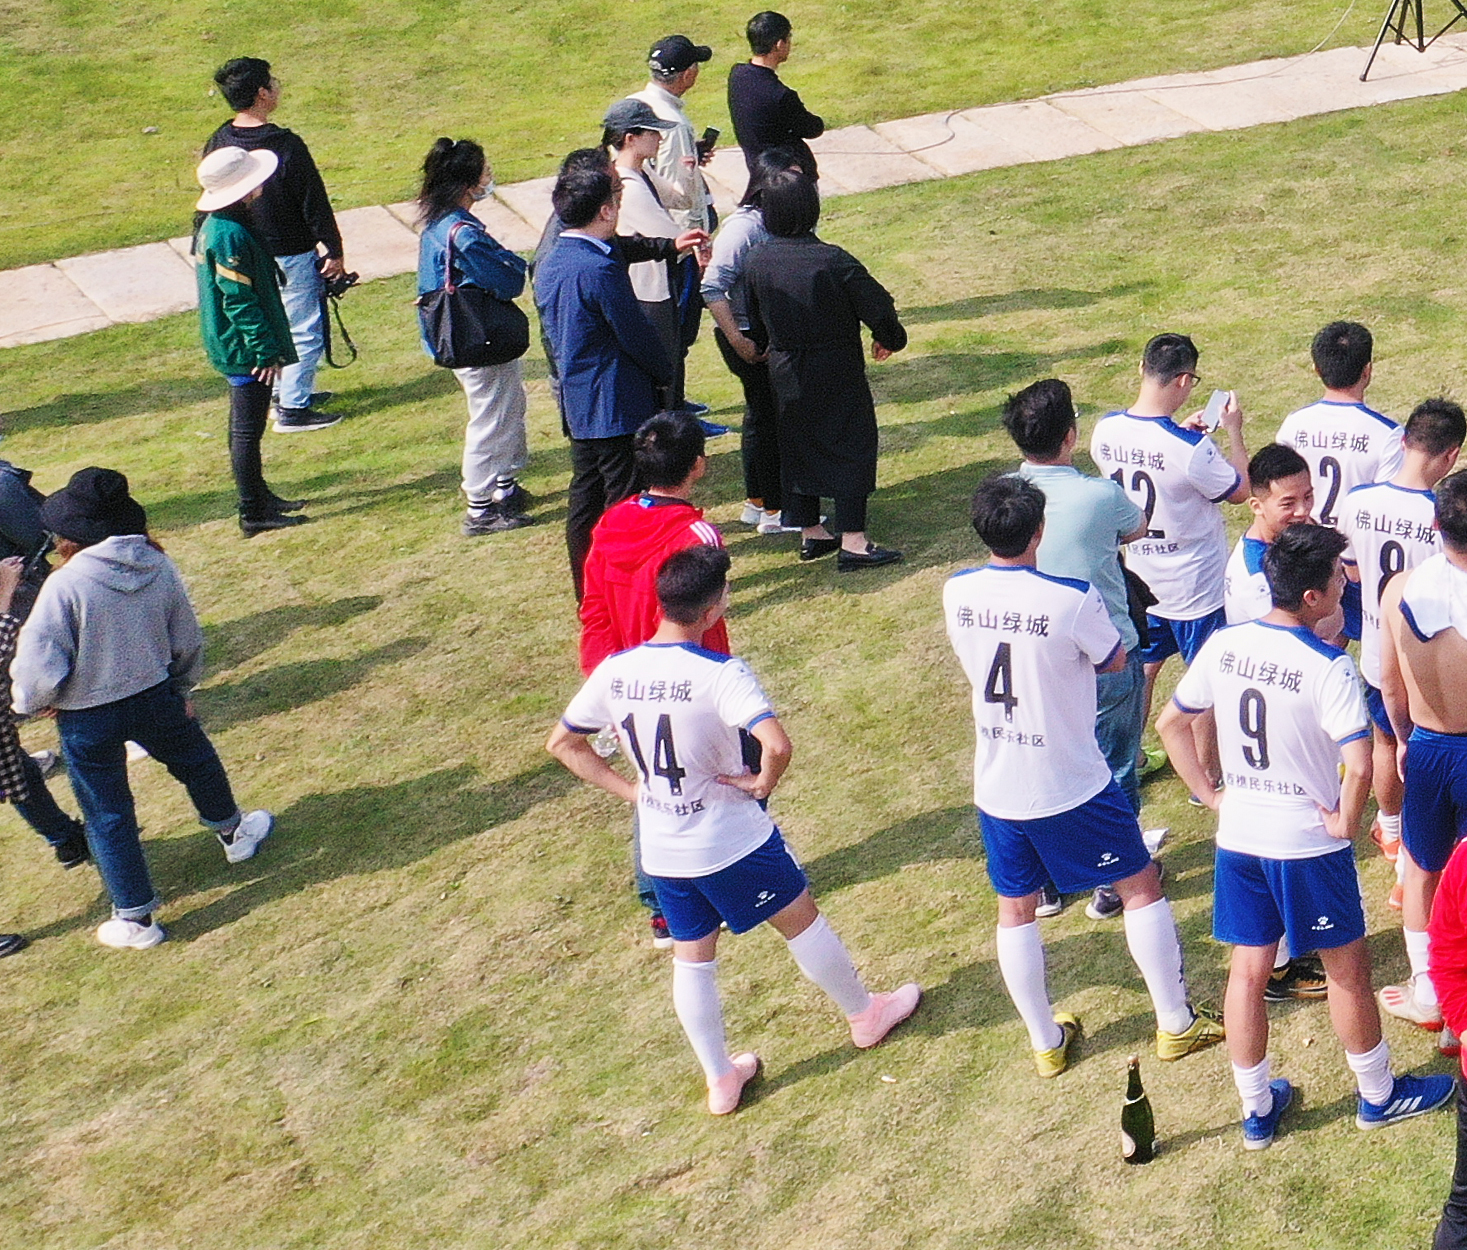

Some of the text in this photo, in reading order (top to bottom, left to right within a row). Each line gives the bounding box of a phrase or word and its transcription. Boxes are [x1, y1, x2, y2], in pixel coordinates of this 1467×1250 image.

[1294, 430, 1371, 453] 佛山绿城
[1110, 467, 1166, 539] 2
[1319, 455, 1342, 526] 2
[1356, 508, 1436, 545] 佛山绿城
[957, 605, 1050, 637] 佛山绿城
[610, 677, 693, 703] 佛山绿城
[984, 641, 1018, 723] 4
[1219, 650, 1304, 694] 佛山绿城
[621, 713, 686, 796] 14
[1239, 688, 1270, 771] 9
